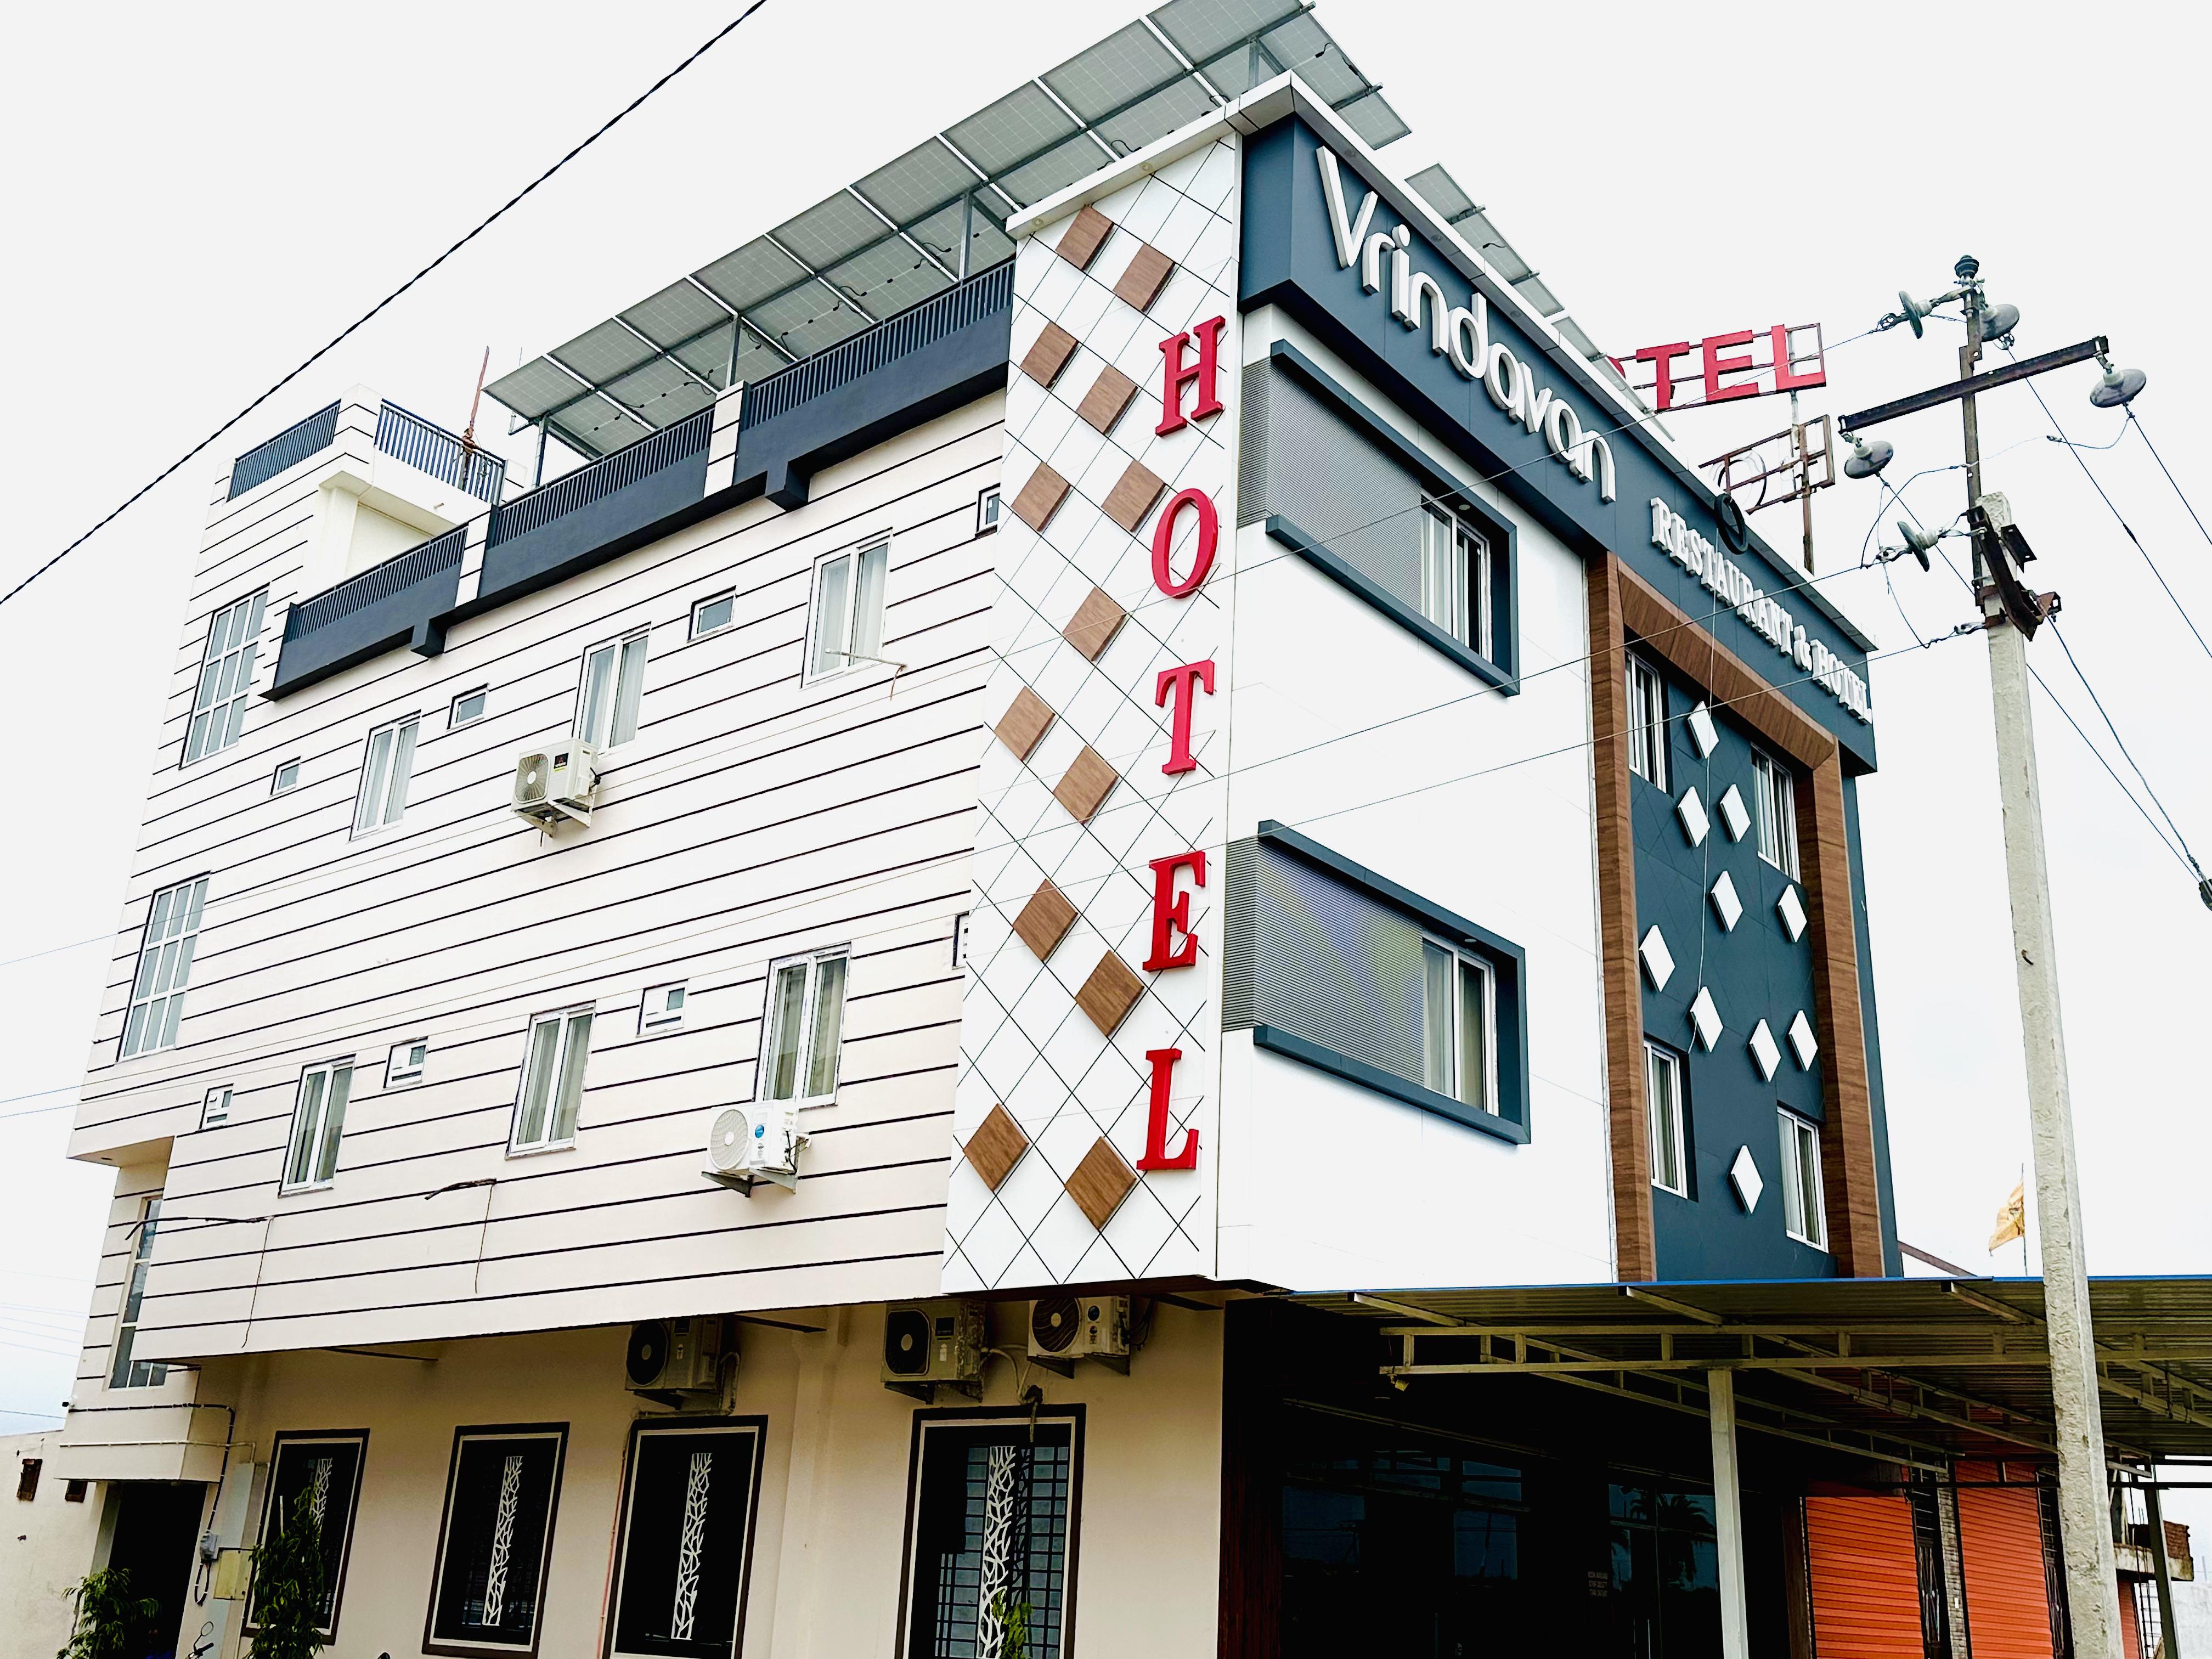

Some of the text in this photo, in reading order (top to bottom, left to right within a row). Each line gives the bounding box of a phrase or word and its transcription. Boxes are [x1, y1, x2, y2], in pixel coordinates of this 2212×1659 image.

[1316, 145, 1616, 504] Vrindavan
[1606, 324, 1827, 413] TEL
[1136, 315, 1226, 1171] HOTEL
[1650, 496, 1872, 726] RESTAURANT & HOTEL
